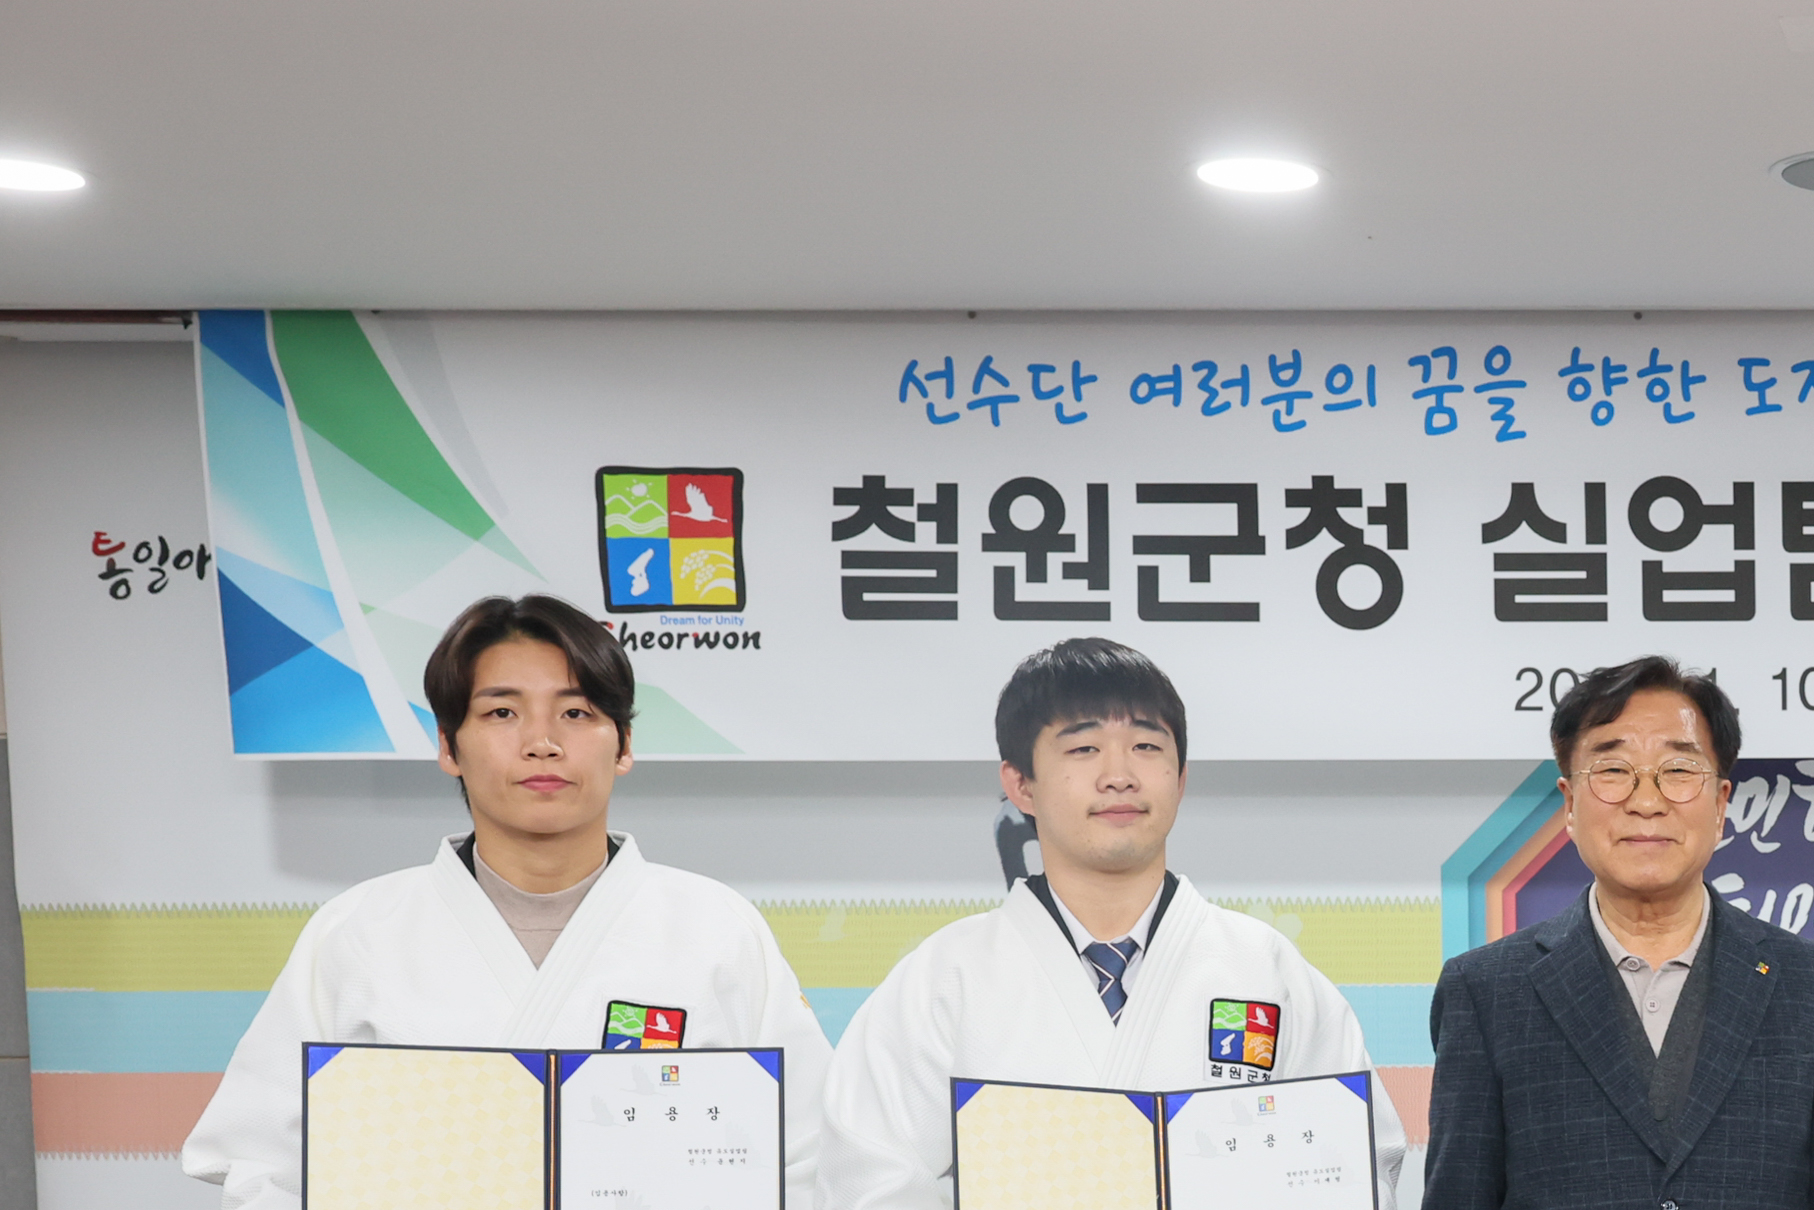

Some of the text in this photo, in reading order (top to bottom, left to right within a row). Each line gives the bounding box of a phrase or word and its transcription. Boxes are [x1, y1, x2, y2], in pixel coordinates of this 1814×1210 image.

[901, 357, 1098, 428] 선수단
[1132, 351, 1377, 433] 여러분의
[1410, 347, 1527, 443] 꿈을
[1561, 348, 1707, 427] 향한
[833, 477, 1409, 631] 철원군청
[598, 621, 761, 651] heorwon
[659, 615, 745, 627] Dream for Unity
